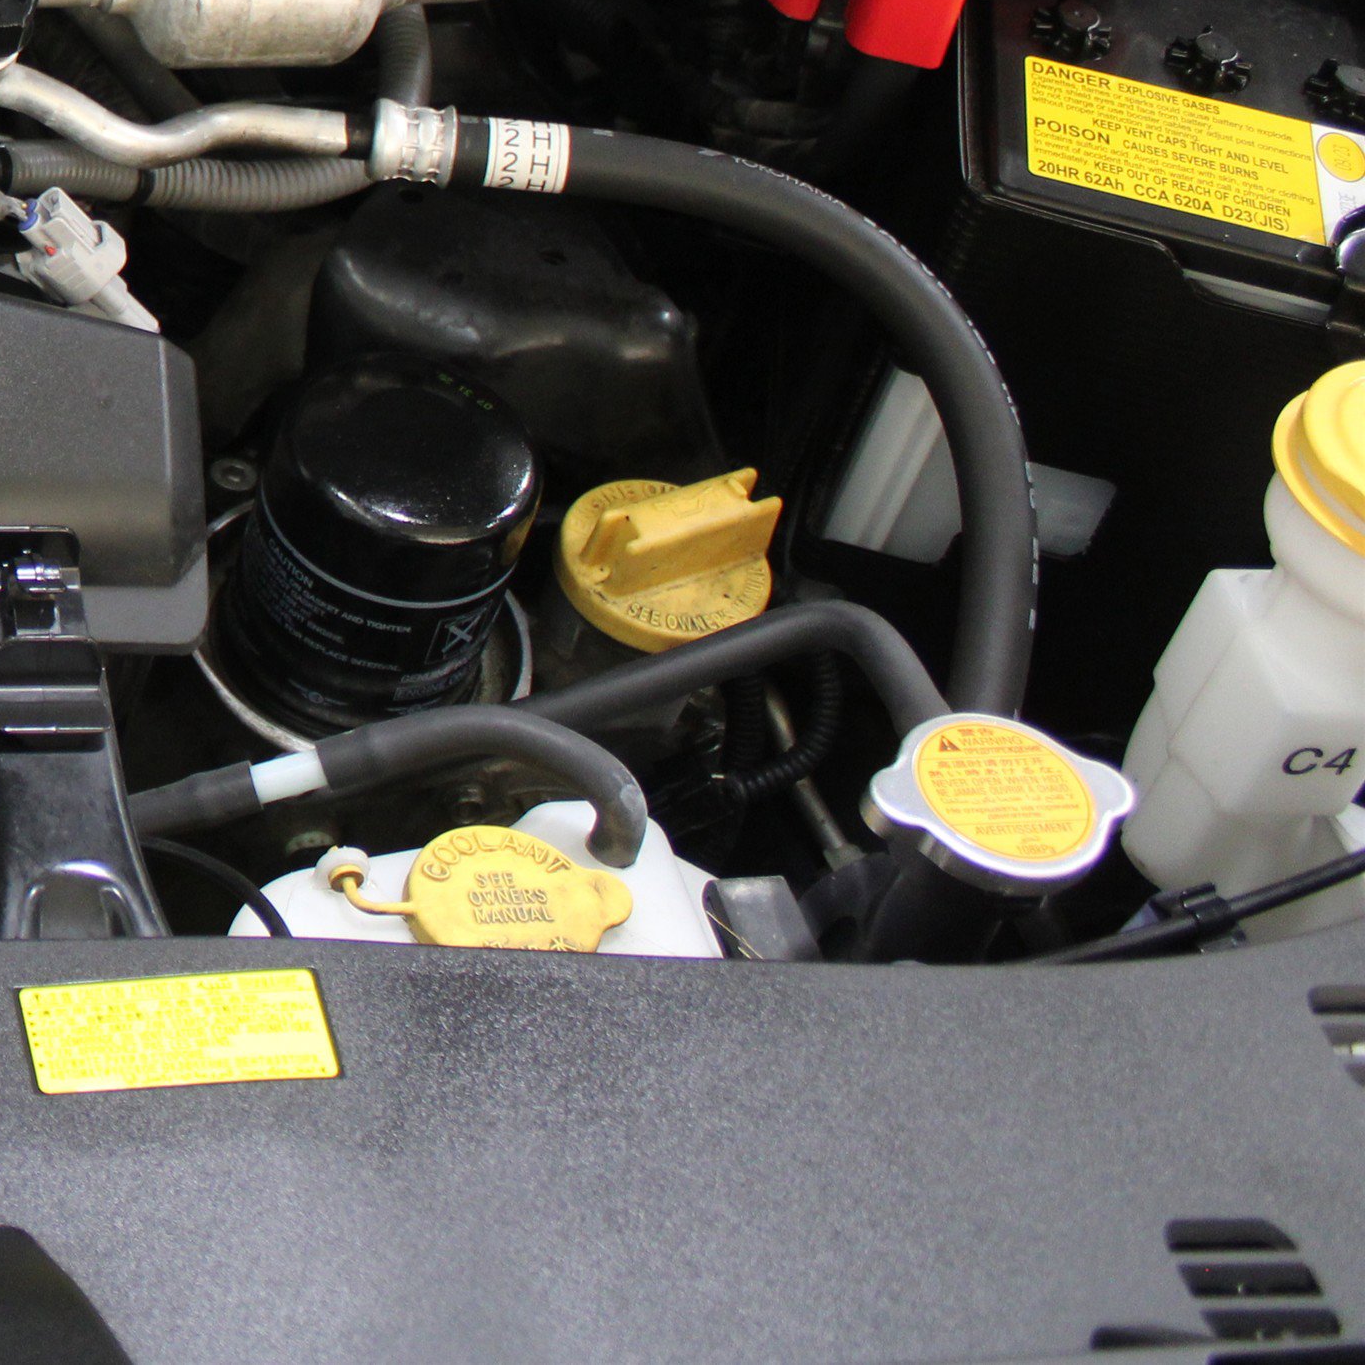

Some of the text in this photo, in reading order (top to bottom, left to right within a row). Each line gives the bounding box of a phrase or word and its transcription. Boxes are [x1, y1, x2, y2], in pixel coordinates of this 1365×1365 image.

[1032, 60, 1219, 115] DANGER EXPLOSIVE GASES
[503, 127, 553, 151] 2 H
[1034, 116, 1259, 181] POISON CAUSES SEVERE BURNS
[1092, 117, 1288, 174] KEEP VENT CAPS TIGHT AND LEVEL
[501, 152, 552, 177] 2 H
[1037, 159, 1289, 232] 20HR 62Ah CCA 620A D23(JIS)
[1094, 160, 1123, 176] KEEP
[1126, 168, 1149, 182] OUT
[1153, 174, 1167, 187] OF
[1171, 179, 1210, 197] REACH
[1214, 190, 1228, 201] OF
[1232, 194, 1291, 217] CHILDREN
[268, 538, 314, 589] CAUTION
[340, 611, 364, 626] AND
[365, 619, 413, 634] TIGHTEN
[627, 602, 661, 626] SEE
[958, 736, 1023, 747] WARNING
[1282, 746, 1357, 776] C4
[974, 822, 1075, 836] AVERTISSEMENT
[421, 830, 572, 882] COOLANT
[473, 870, 517, 890] SEE
[467, 888, 550, 908] OWNERS
[472, 906, 556, 926] MANUAL
